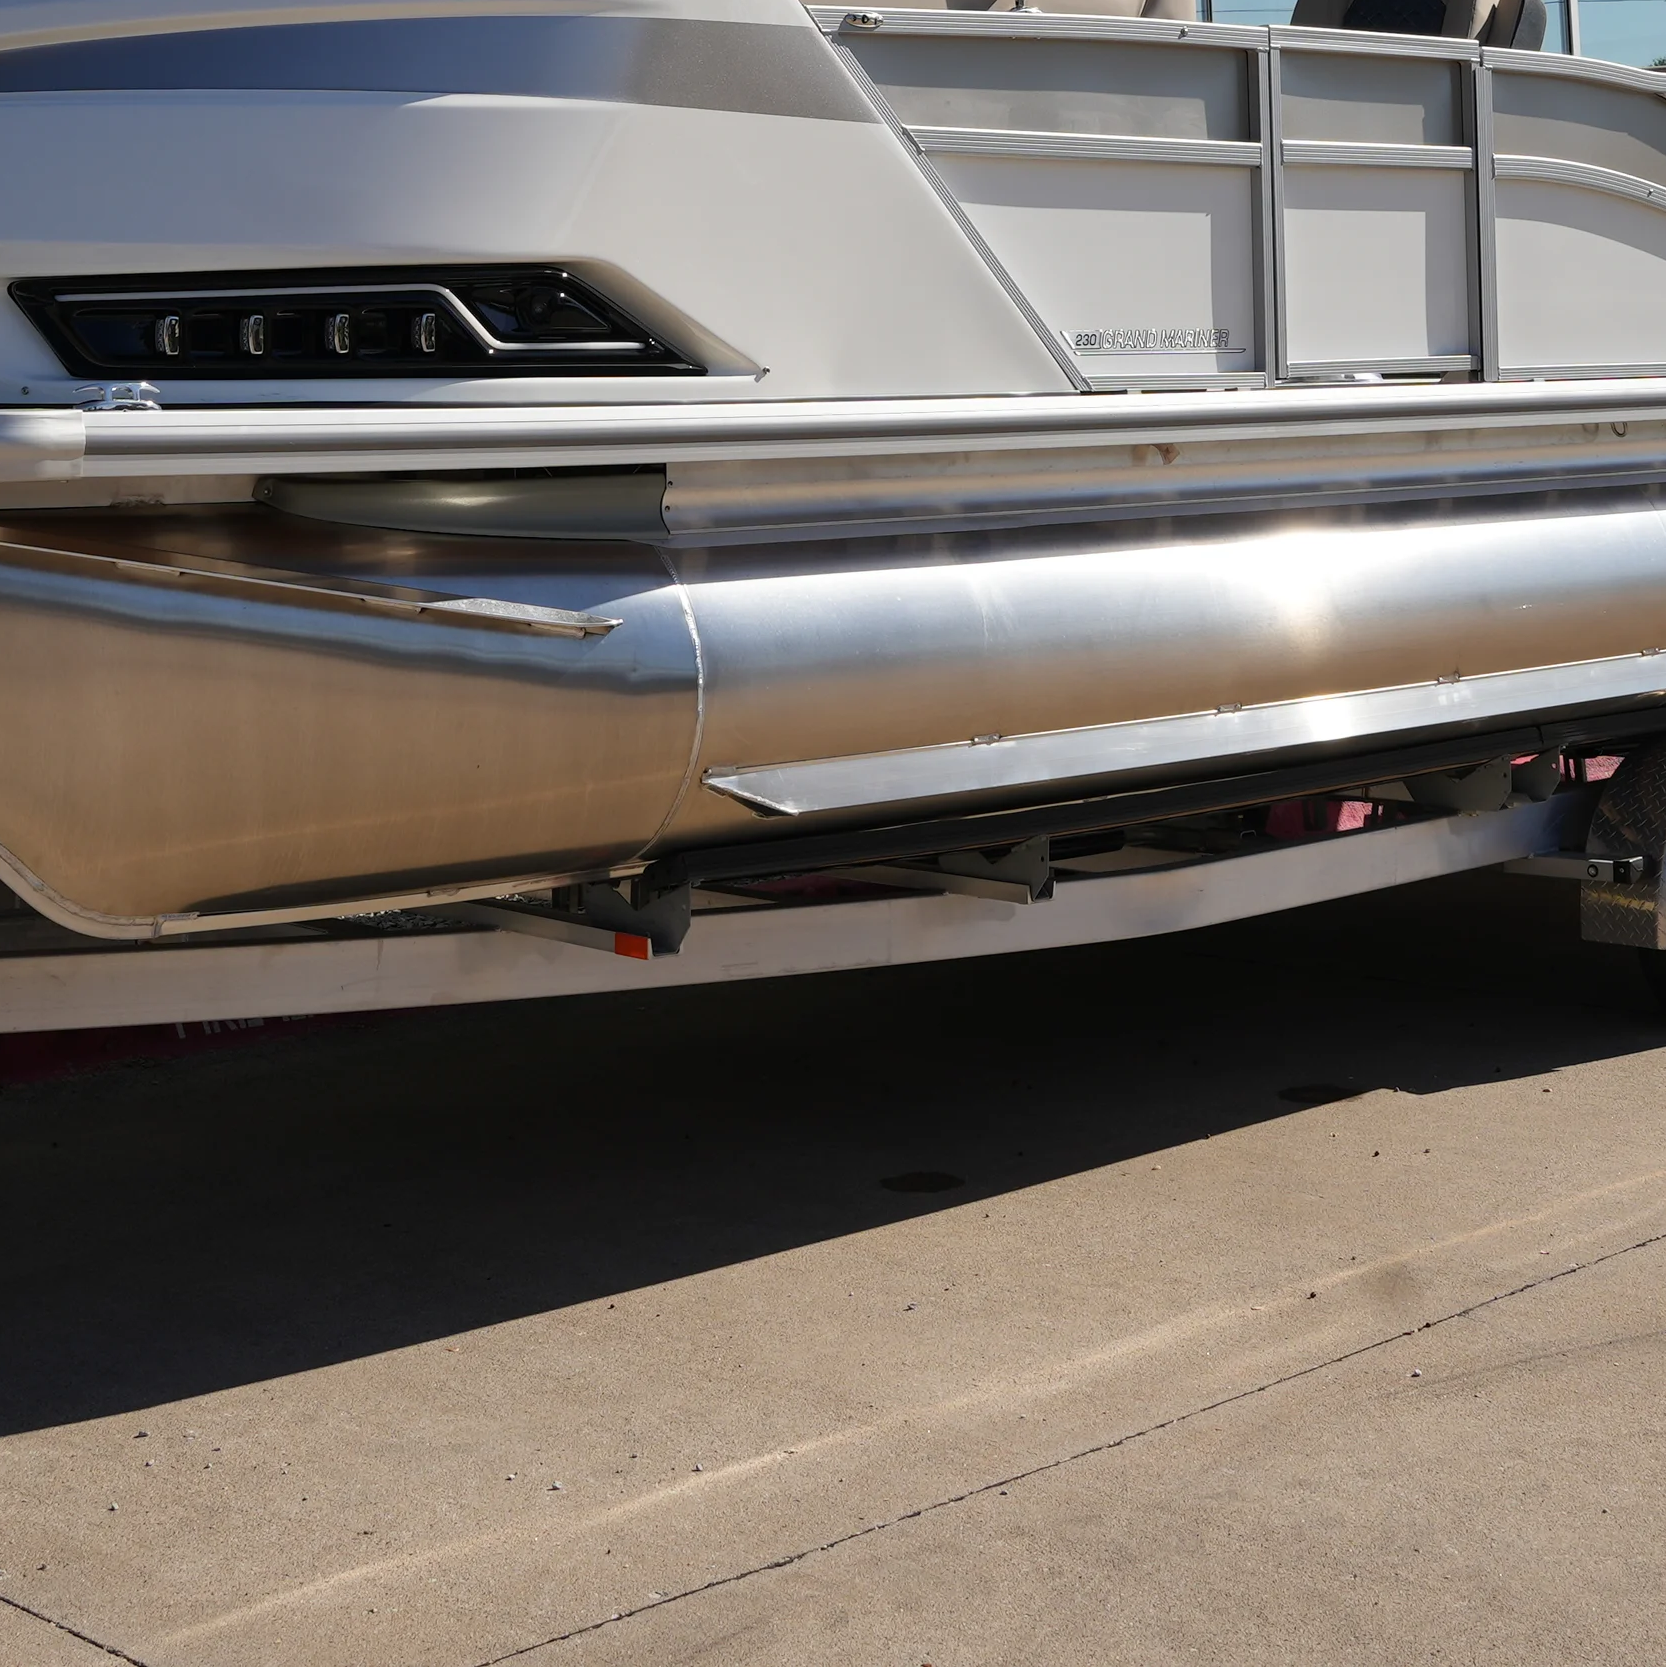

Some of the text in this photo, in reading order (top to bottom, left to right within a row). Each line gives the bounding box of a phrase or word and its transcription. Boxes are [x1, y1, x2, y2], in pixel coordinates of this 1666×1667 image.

[1075, 328, 1229, 349] 230 GRAND MARINER
